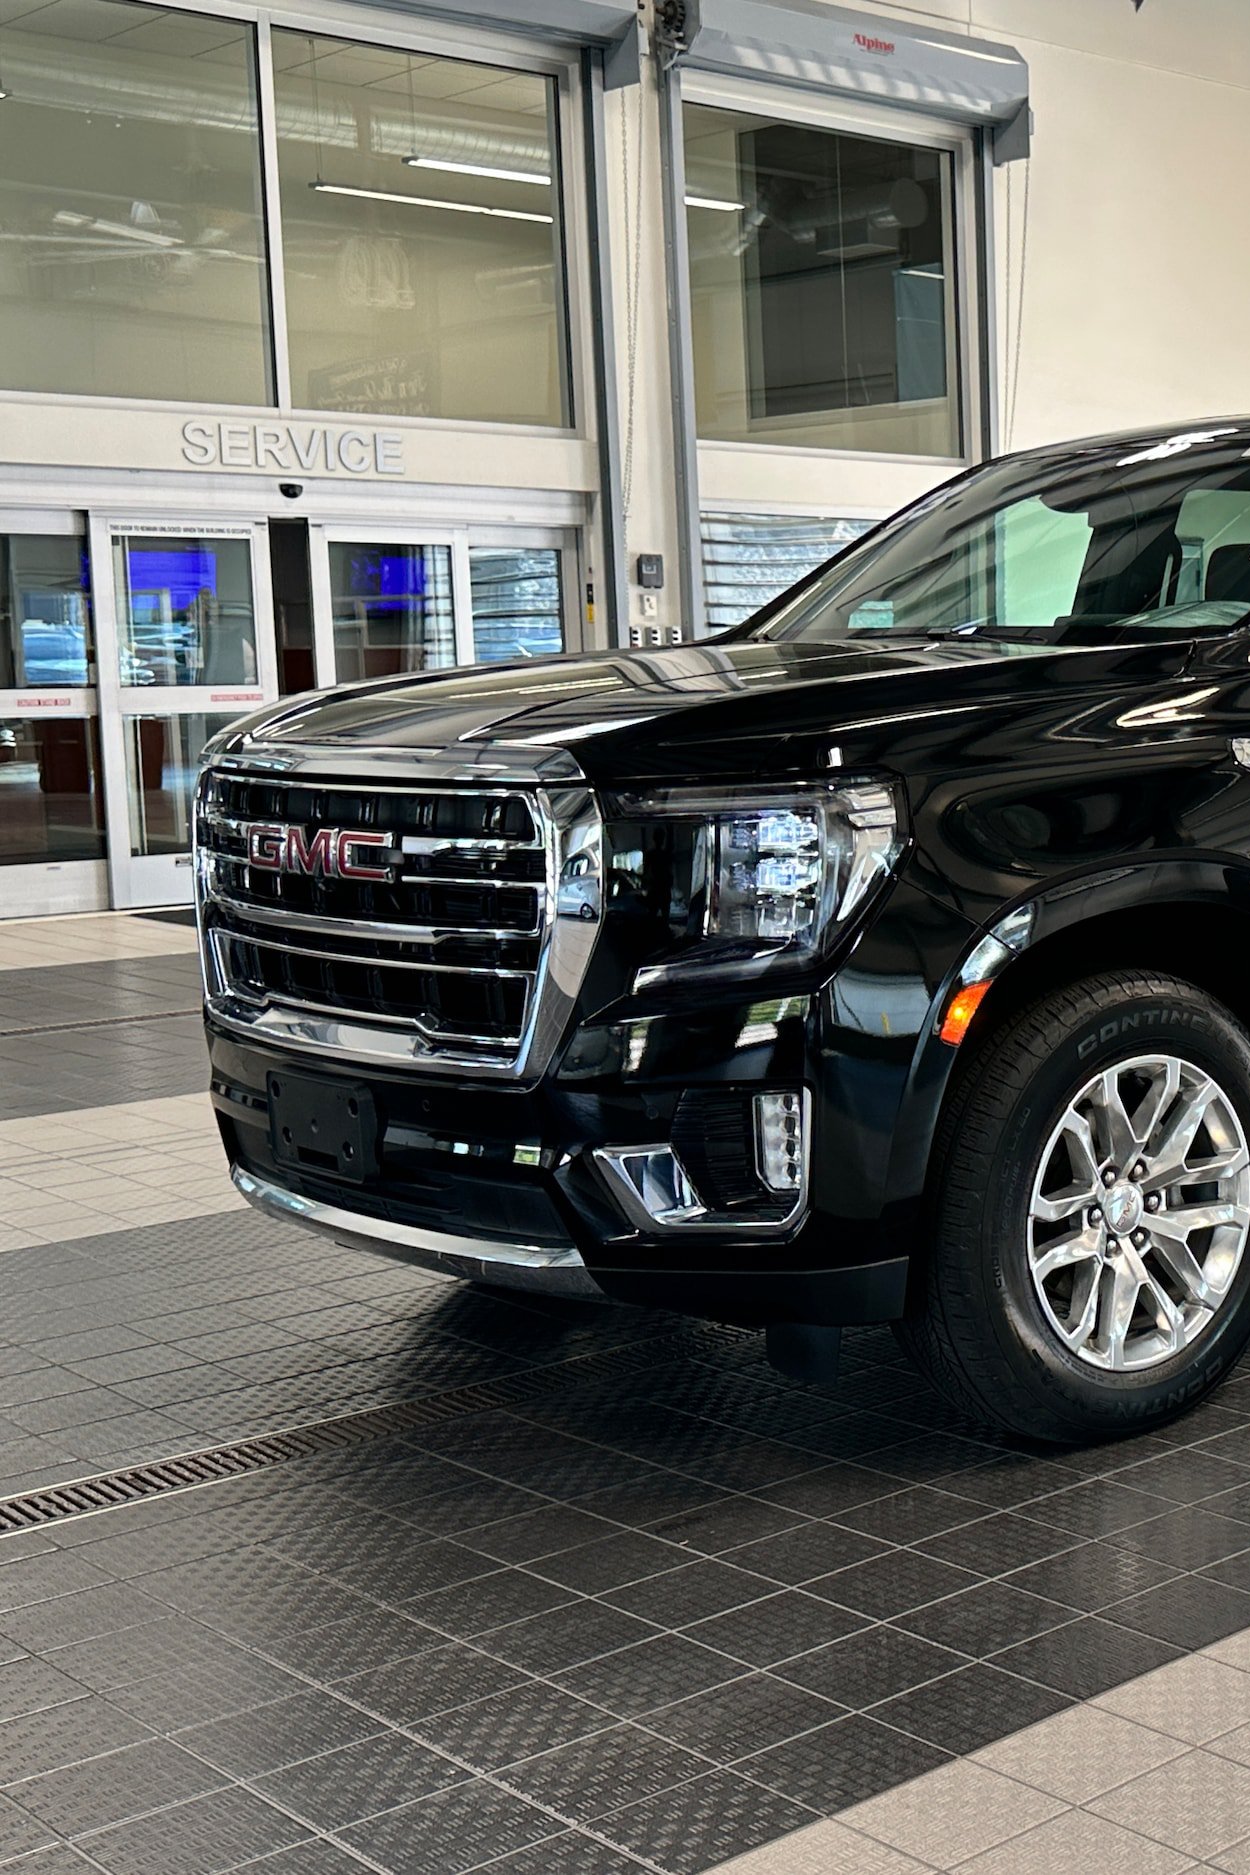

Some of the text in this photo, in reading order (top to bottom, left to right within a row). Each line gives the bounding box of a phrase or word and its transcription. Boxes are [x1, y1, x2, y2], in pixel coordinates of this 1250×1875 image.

[852, 33, 895, 53] Alpine
[182, 421, 405, 474] SERVICE
[248, 822, 395, 884] GMC
